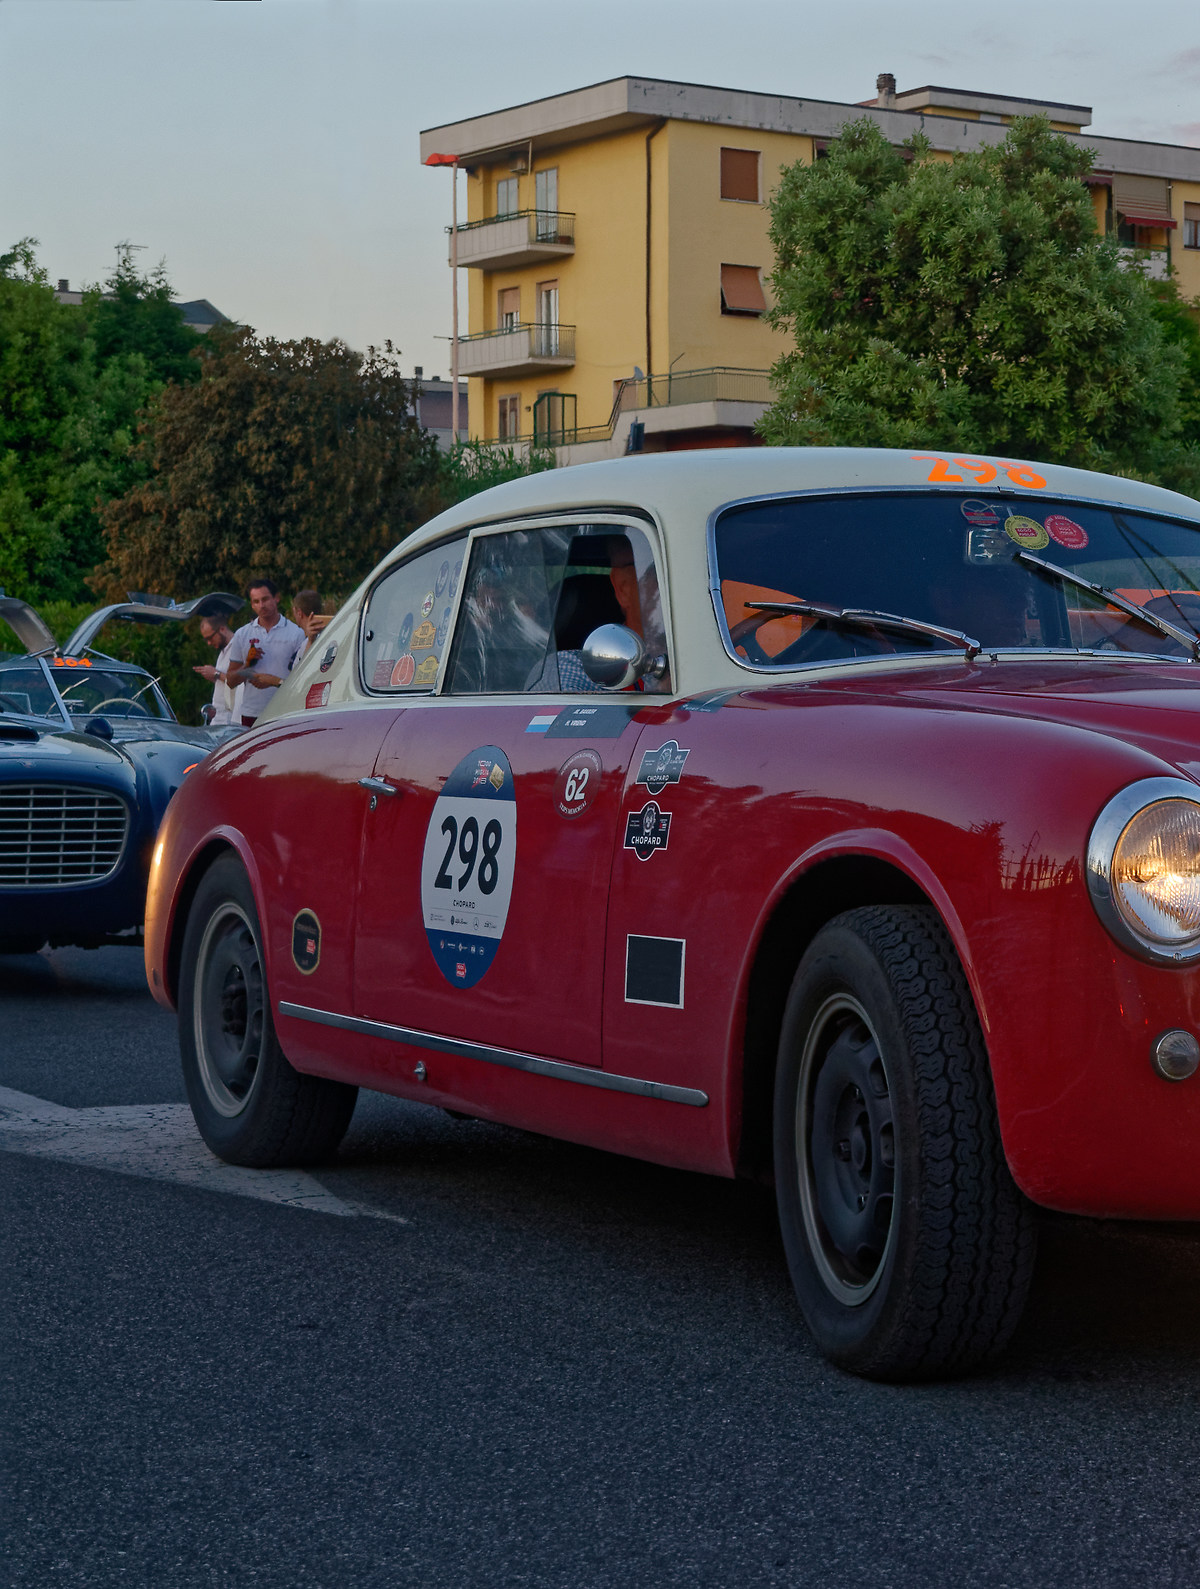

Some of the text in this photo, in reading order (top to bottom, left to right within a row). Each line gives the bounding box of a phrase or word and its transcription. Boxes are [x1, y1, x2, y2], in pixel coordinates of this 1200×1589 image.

[909, 456, 1047, 489] 298
[53, 657, 92, 668] 364
[647, 774, 670, 782] CHOPARD
[565, 767, 590, 802] 62
[630, 836, 662, 846] CHOPARD
[434, 815, 503, 896] 298
[453, 899, 476, 909] CHOPARD
